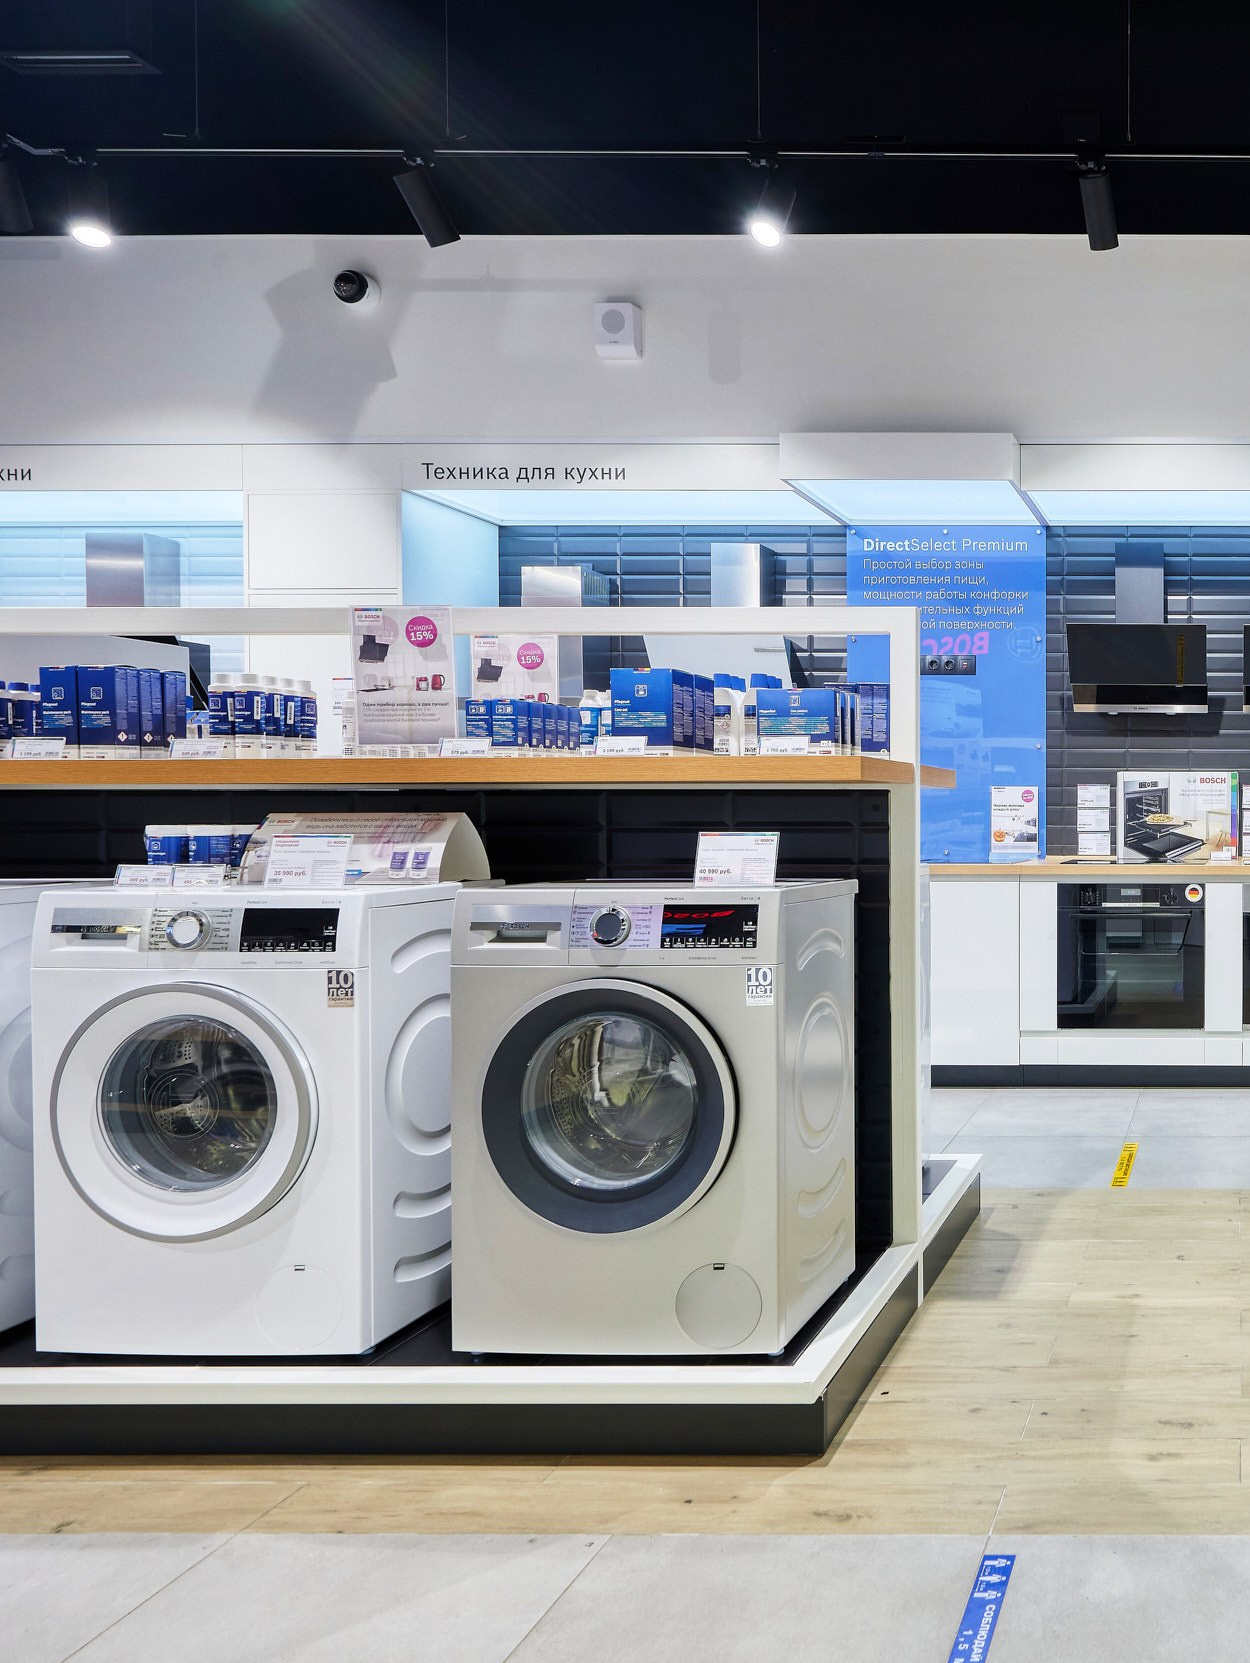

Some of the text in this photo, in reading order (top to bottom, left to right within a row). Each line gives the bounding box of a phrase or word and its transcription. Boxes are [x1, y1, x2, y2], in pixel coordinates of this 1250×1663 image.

[421, 462, 626, 483] Техника для кухни
[863, 538, 1028, 552] DirectSelect Premium
[863, 558, 984, 570] Простой выбор зоны
[863, 576, 989, 586] приготовления пищи,
[863, 588, 1029, 601] мощности работы конфорки
[973, 603, 1024, 616] функций
[408, 624, 434, 632] Скидка
[939, 620, 1016, 631] поверхности.
[409, 631, 434, 641] 15%
[520, 656, 541, 664] 15%
[328, 970, 353, 988] 10
[747, 967, 772, 986] 10
[328, 988, 354, 997] лет
[747, 985, 772, 995] лет
[969, 1604, 996, 1662] СОБЛЮДАЙ
